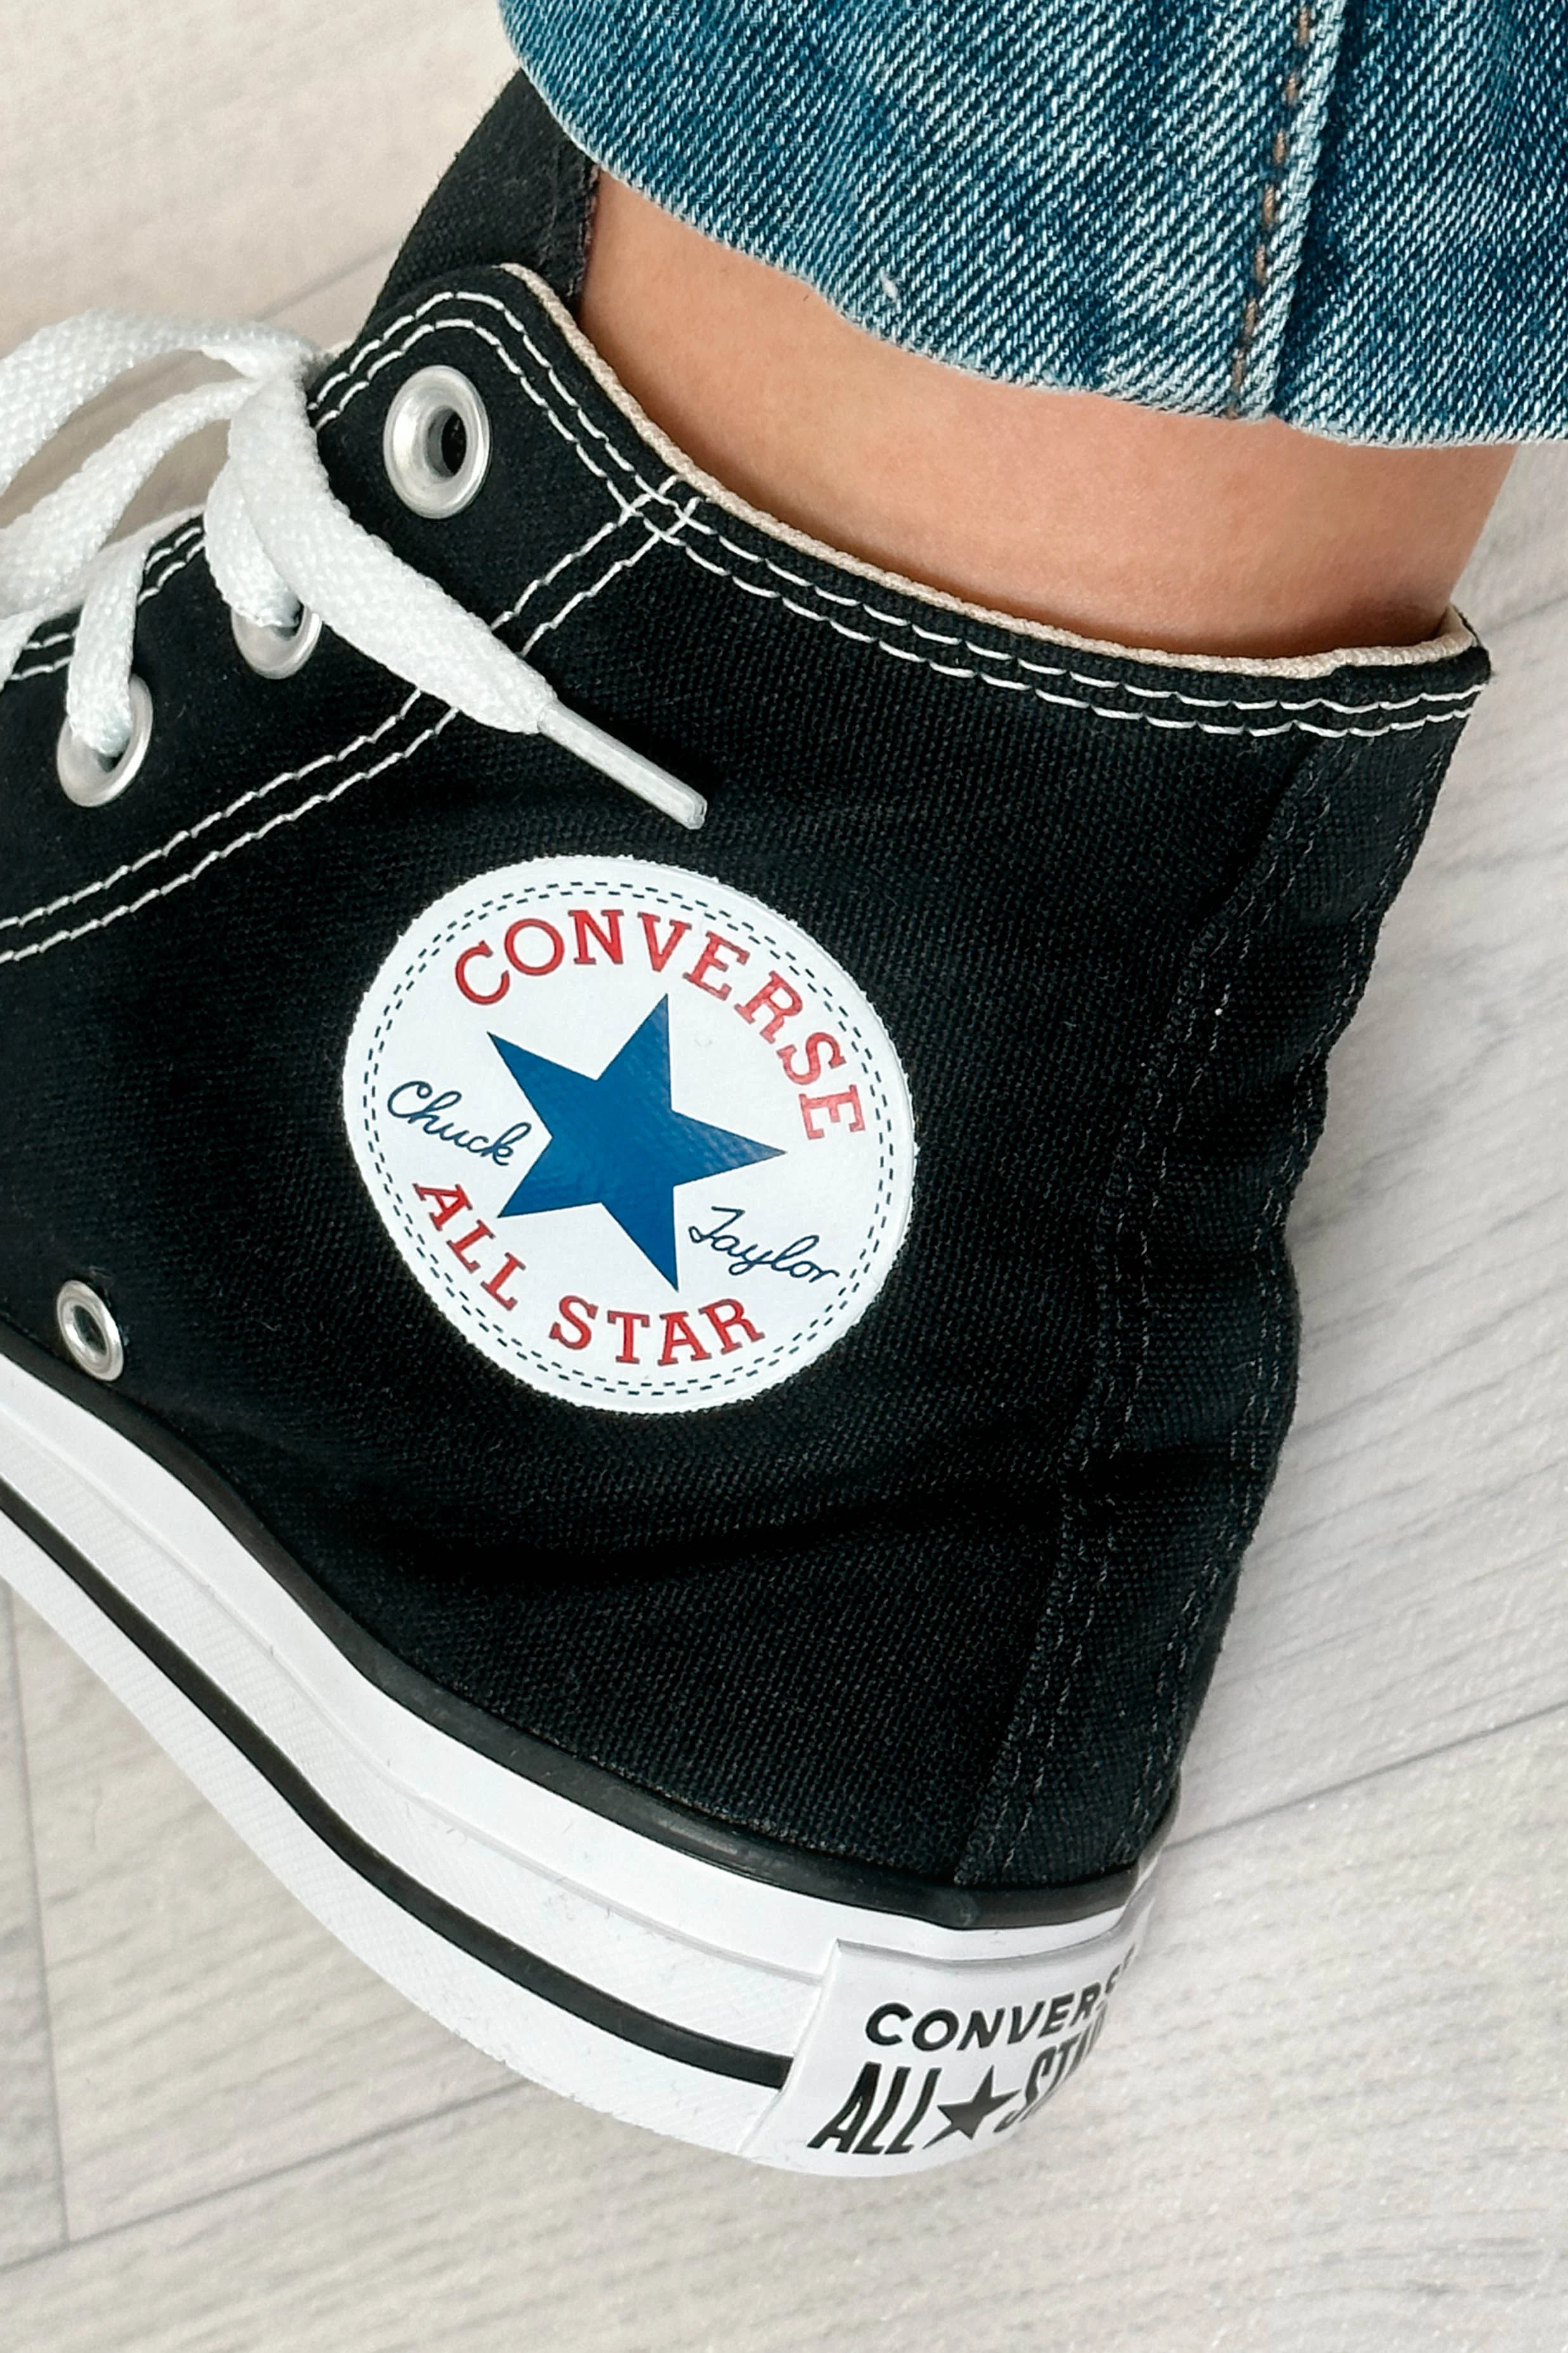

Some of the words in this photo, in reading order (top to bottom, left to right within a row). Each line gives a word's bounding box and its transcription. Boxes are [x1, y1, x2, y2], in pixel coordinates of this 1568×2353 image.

[454, 909, 865, 1140] CONVERSE
[386, 1080, 532, 1166] Chuck
[689, 1206, 840, 1283] Taylor
[413, 1183, 526, 1311] ALL
[549, 1295, 765, 1365] STAR
[807, 2061, 942, 2154] ALL
